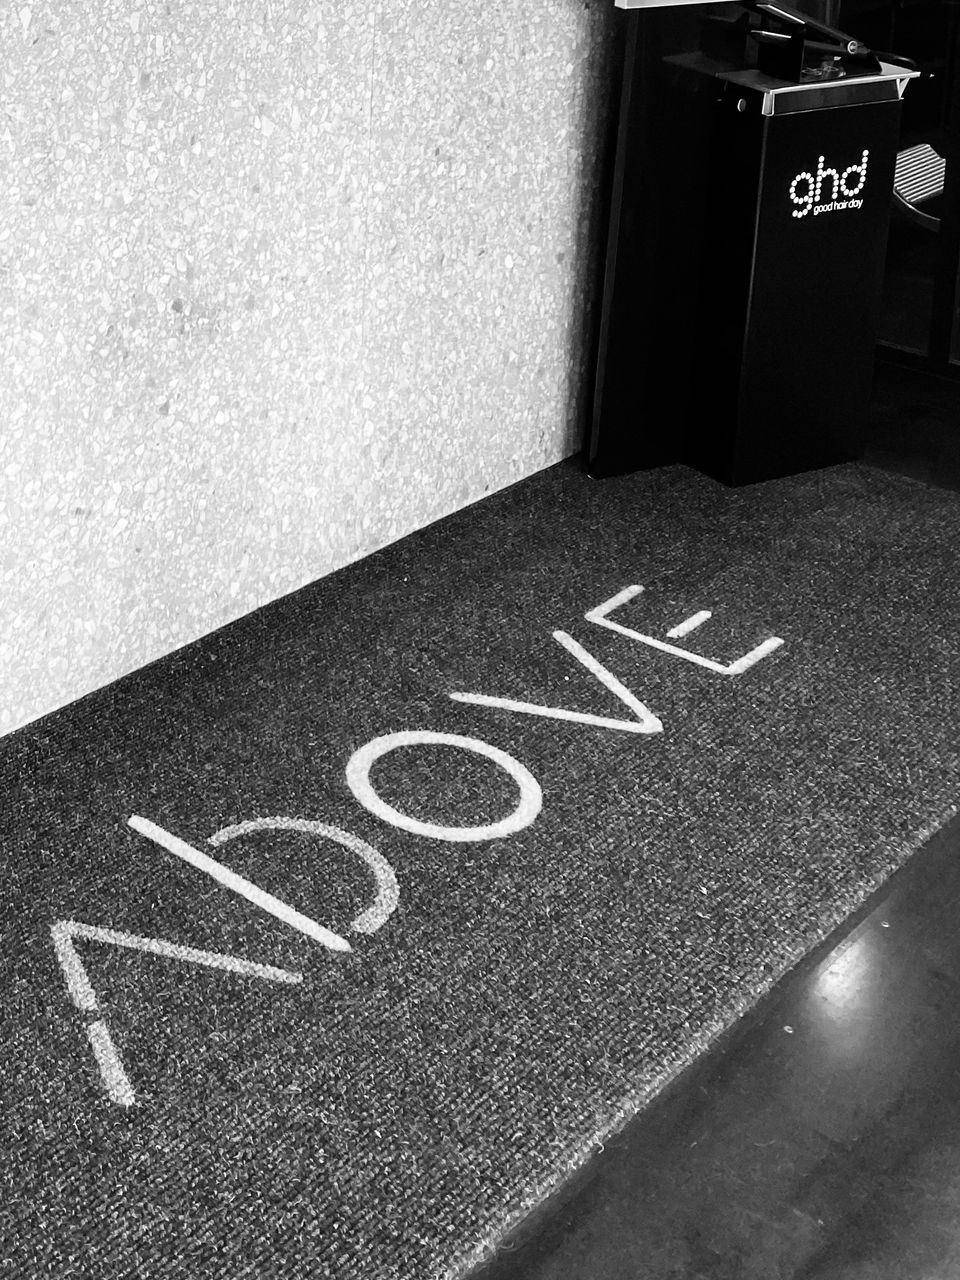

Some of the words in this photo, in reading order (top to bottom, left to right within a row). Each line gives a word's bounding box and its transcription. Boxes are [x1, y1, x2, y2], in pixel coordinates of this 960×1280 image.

[789, 149, 869, 218] ghd
[813, 201, 834, 216] good
[833, 200, 849, 210] hair
[848, 198, 864, 210] day
